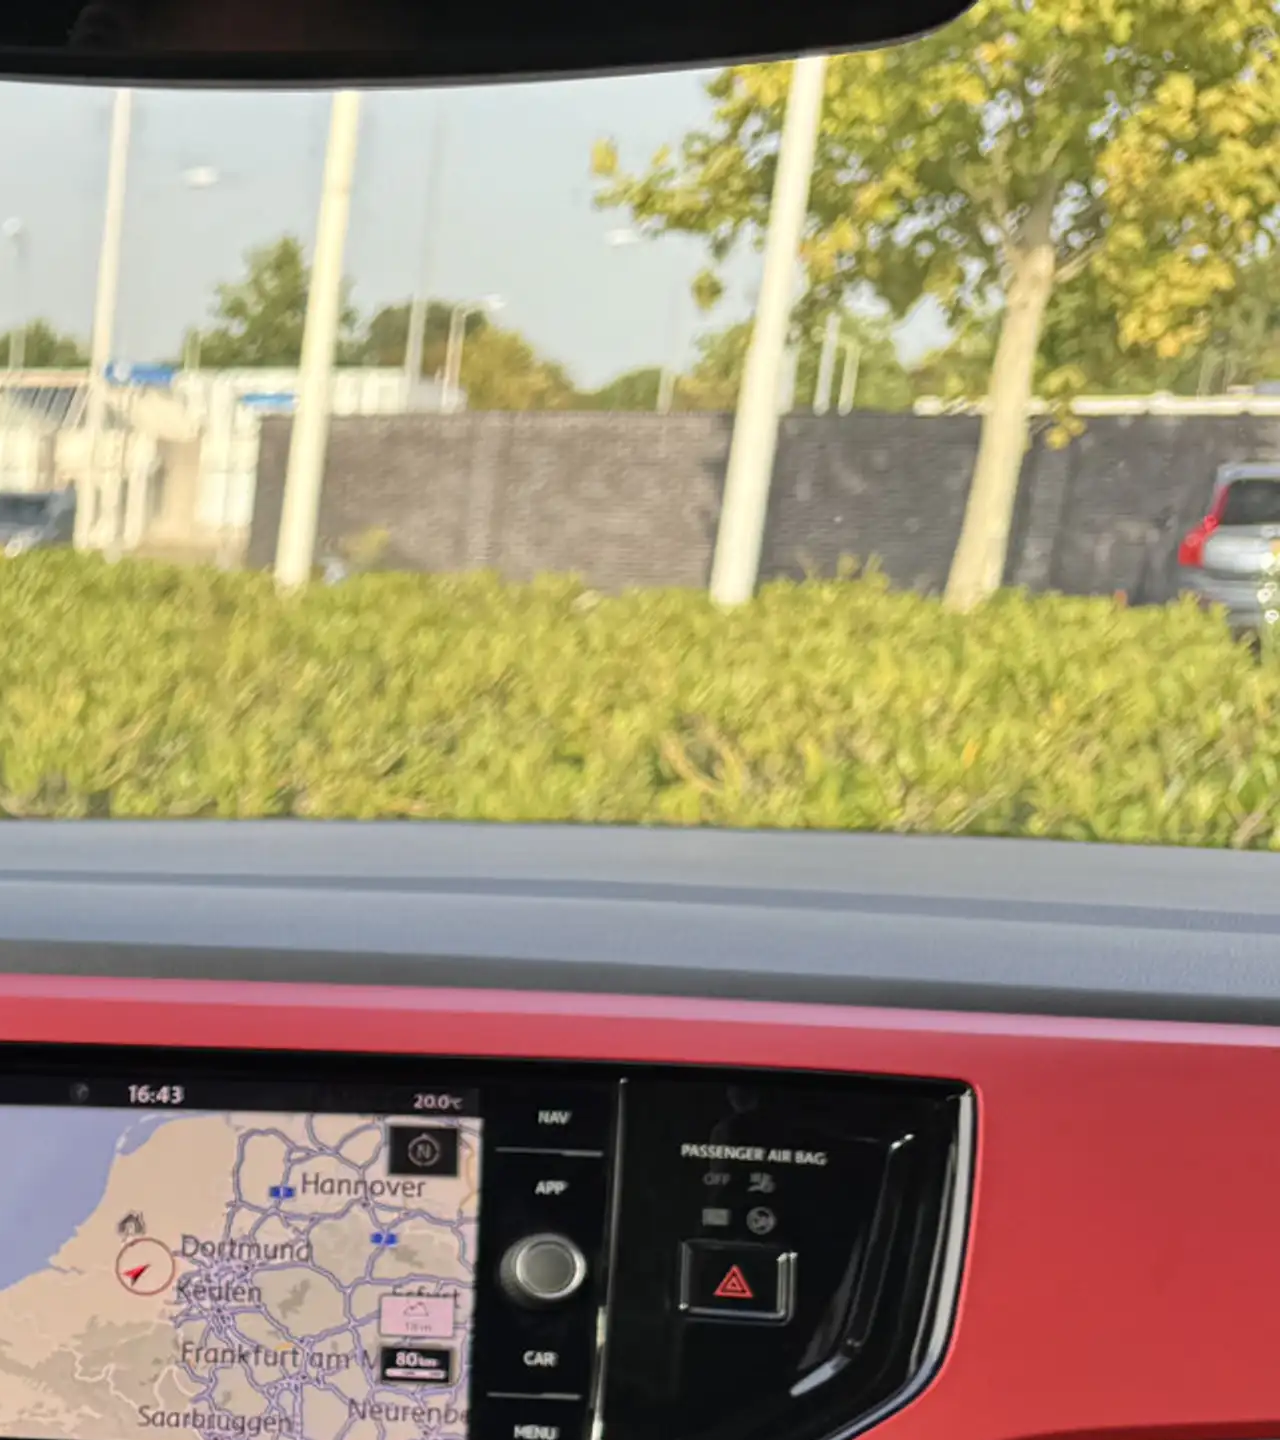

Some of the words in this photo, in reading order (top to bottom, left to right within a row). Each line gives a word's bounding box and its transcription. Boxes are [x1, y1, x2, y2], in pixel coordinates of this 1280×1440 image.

[128, 1084, 185, 1104] 16:43
[538, 1109, 572, 1125] NAV
[681, 1143, 765, 1160] PASSENGER
[768, 1147, 792, 1162] AIR
[795, 1150, 827, 1166] BAG
[301, 1173, 427, 1197] Hannover
[534, 1180, 569, 1195] APP
[182, 1233, 313, 1262] Dortmund
[176, 1279, 262, 1304] Keulen
[182, 1341, 301, 1369] Frankfurt
[310, 1350, 351, 1370] am
[522, 1350, 560, 1367] CAR
[513, 1424, 560, 1440] MENU
